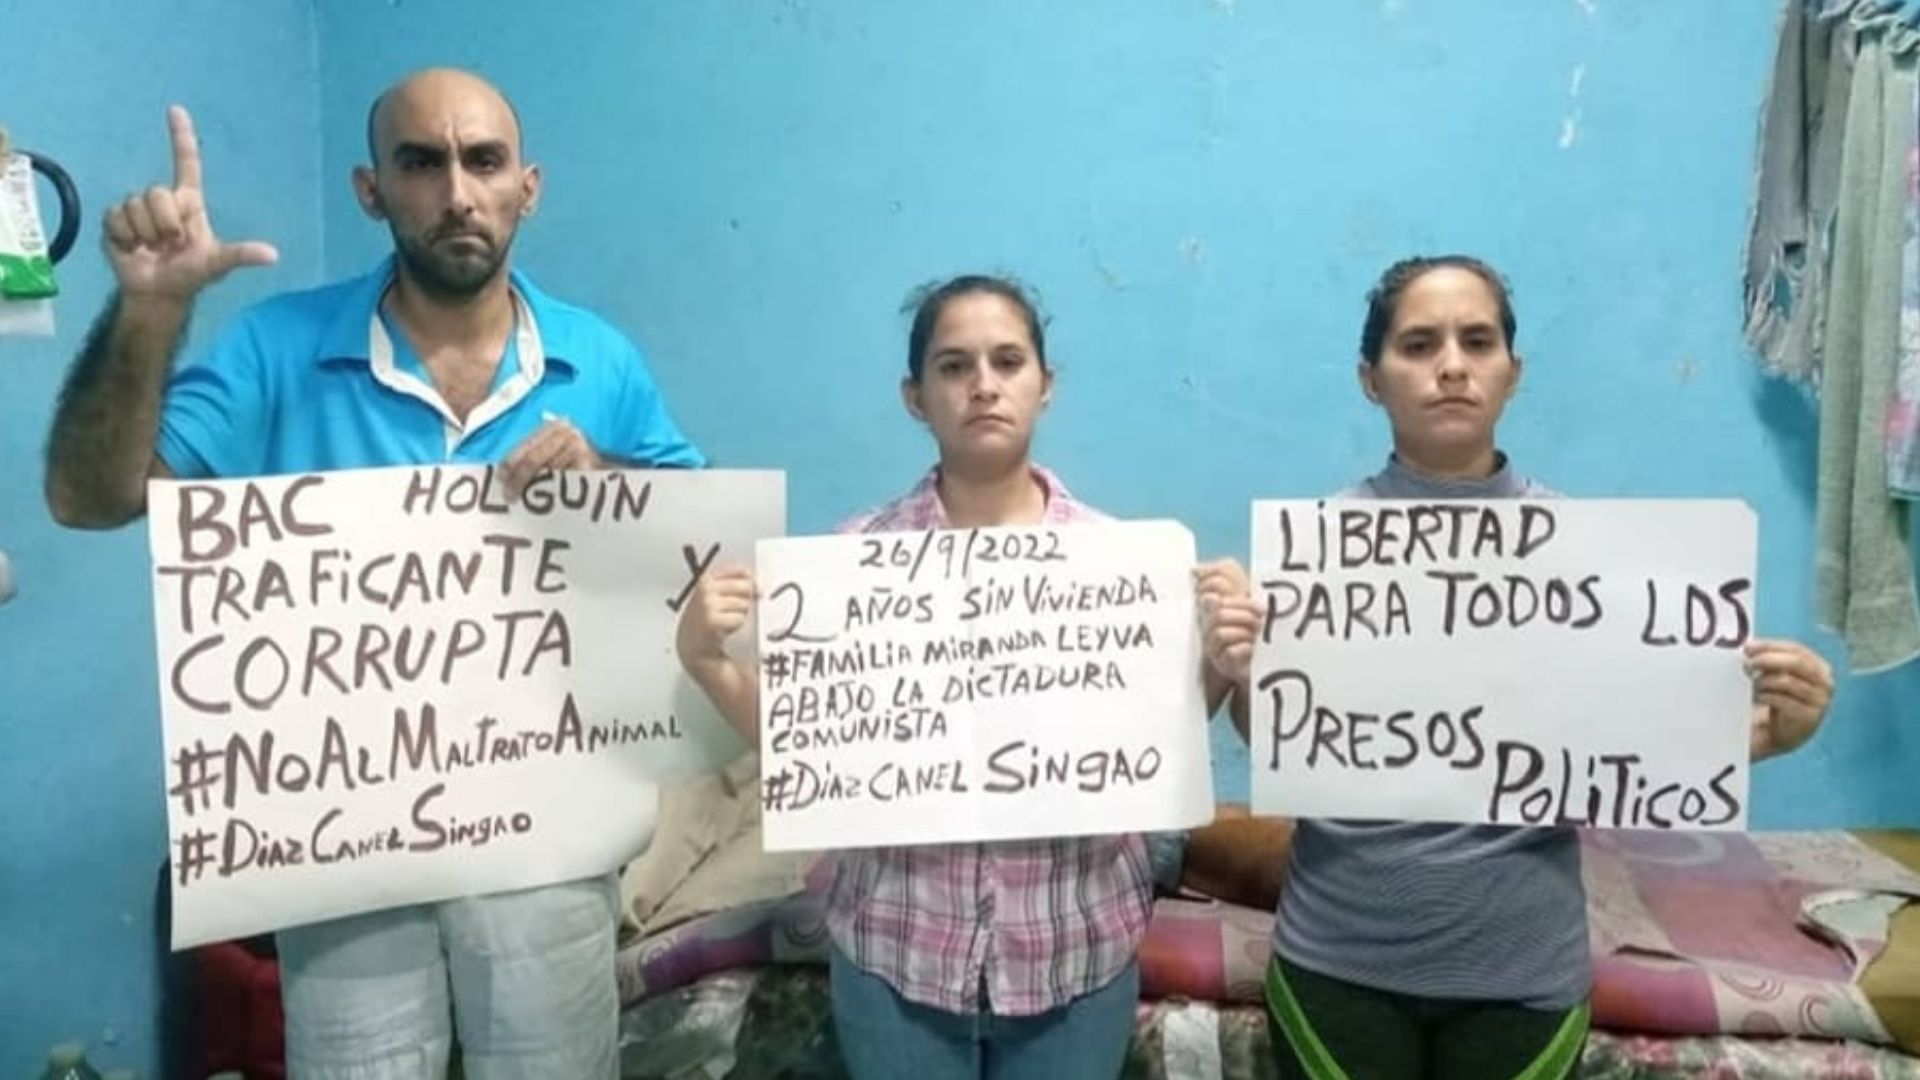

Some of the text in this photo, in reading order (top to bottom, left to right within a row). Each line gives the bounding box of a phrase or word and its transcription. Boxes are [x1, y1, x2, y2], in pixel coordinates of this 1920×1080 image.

[177, 475, 334, 562] BAC
[859, 527, 1067, 583] 26/9/2022
[766, 582, 838, 642] 2
[844, 586, 933, 631] AÑOS
[1057, 622, 1154, 654] LEYVA
[1261, 579, 1411, 643] PARA
[1427, 570, 1603, 636] TODOS
[171, 610, 573, 713] CORRUPTA
[769, 679, 875, 729] ABAJO
[892, 676, 924, 708] LA
[1258, 669, 1485, 770] PRESOS
